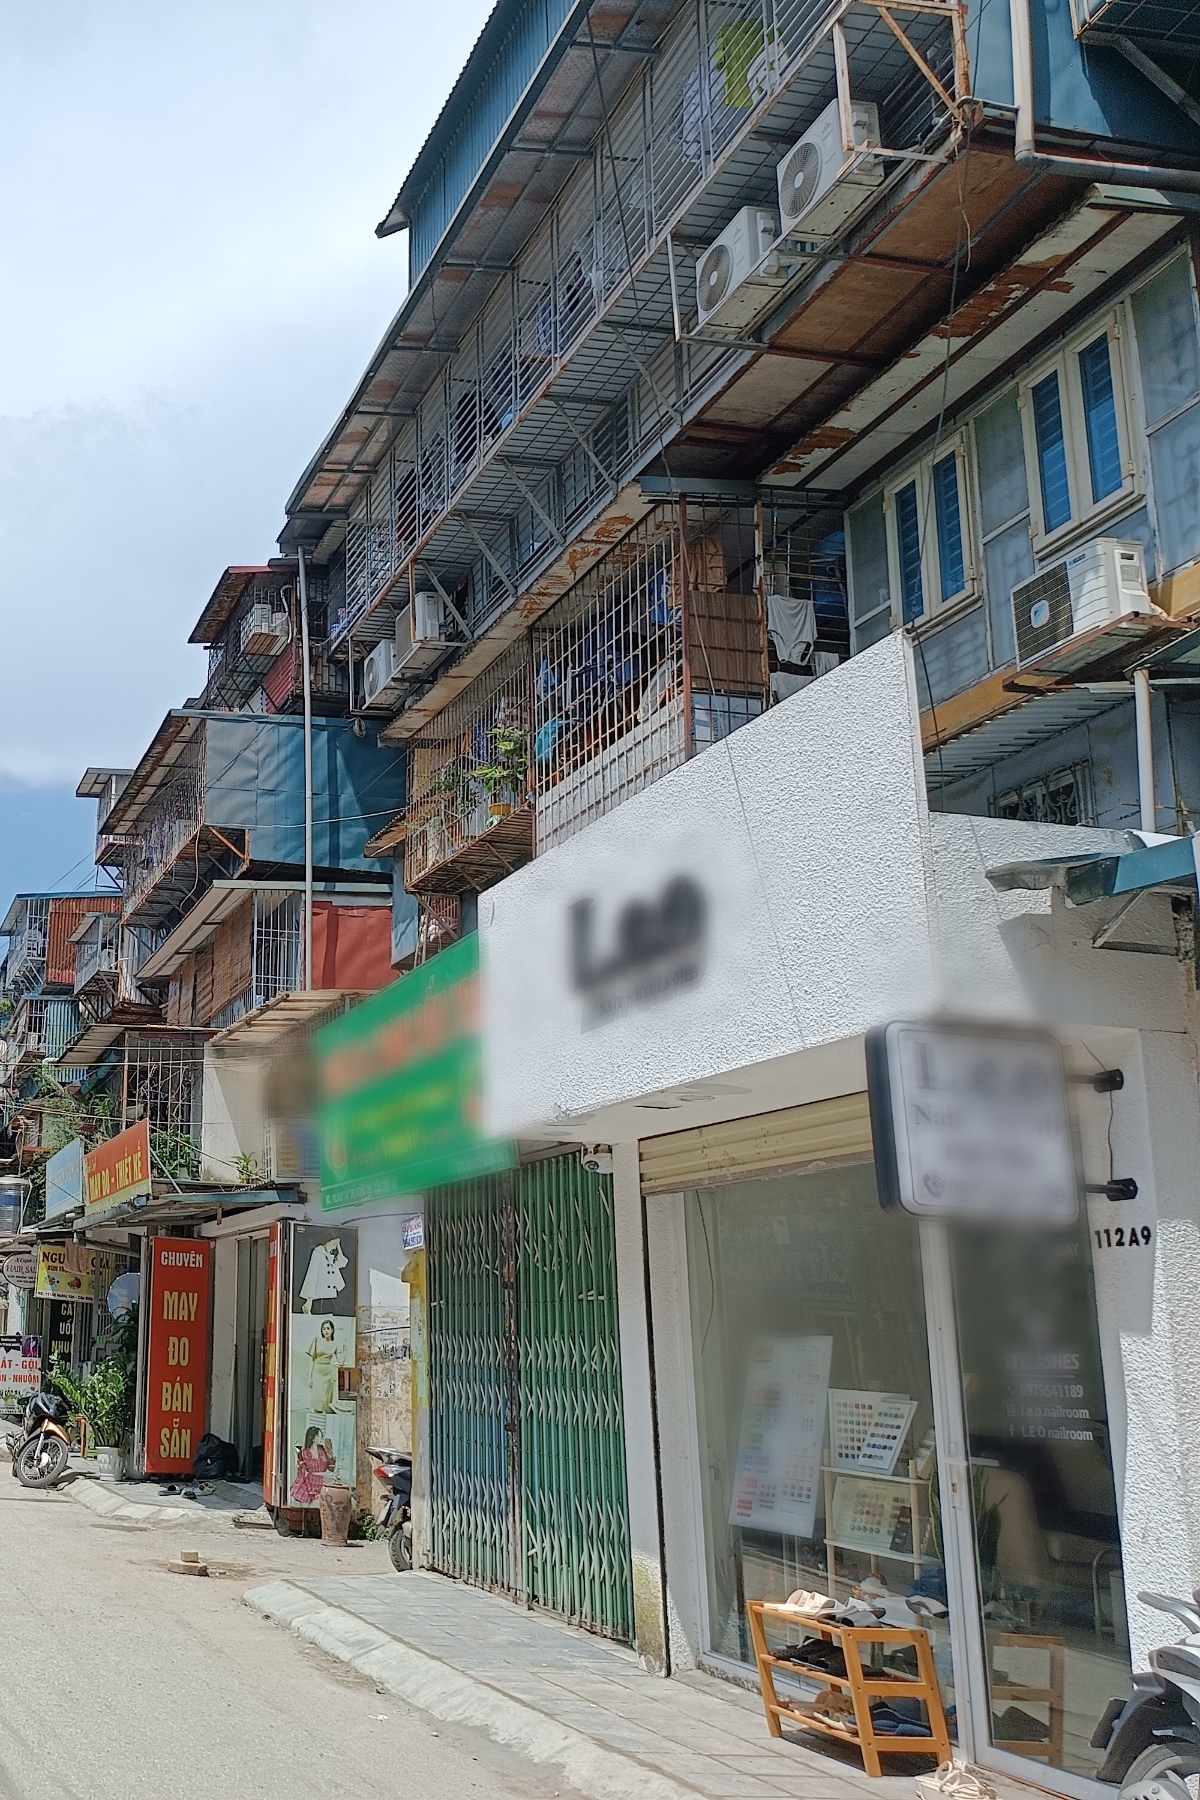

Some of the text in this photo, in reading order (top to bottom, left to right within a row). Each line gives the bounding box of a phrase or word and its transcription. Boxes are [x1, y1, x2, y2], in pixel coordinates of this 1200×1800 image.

[1094, 1226, 1152, 1249] 112A9
[42, 1252, 65, 1264] NGU
[161, 1250, 203, 1268] CHUYÊN
[6, 1265, 24, 1275] HAIR
[163, 1290, 198, 1322] MAY
[59, 1318, 71, 1335] UỐ
[168, 1336, 190, 1367] ĐO
[1004, 1353, 1080, 1370] EYELASHES
[161, 1376, 193, 1413] BÁN
[159, 1417, 191, 1459] SẴN
[1047, 1425, 1094, 1441] nailroom
